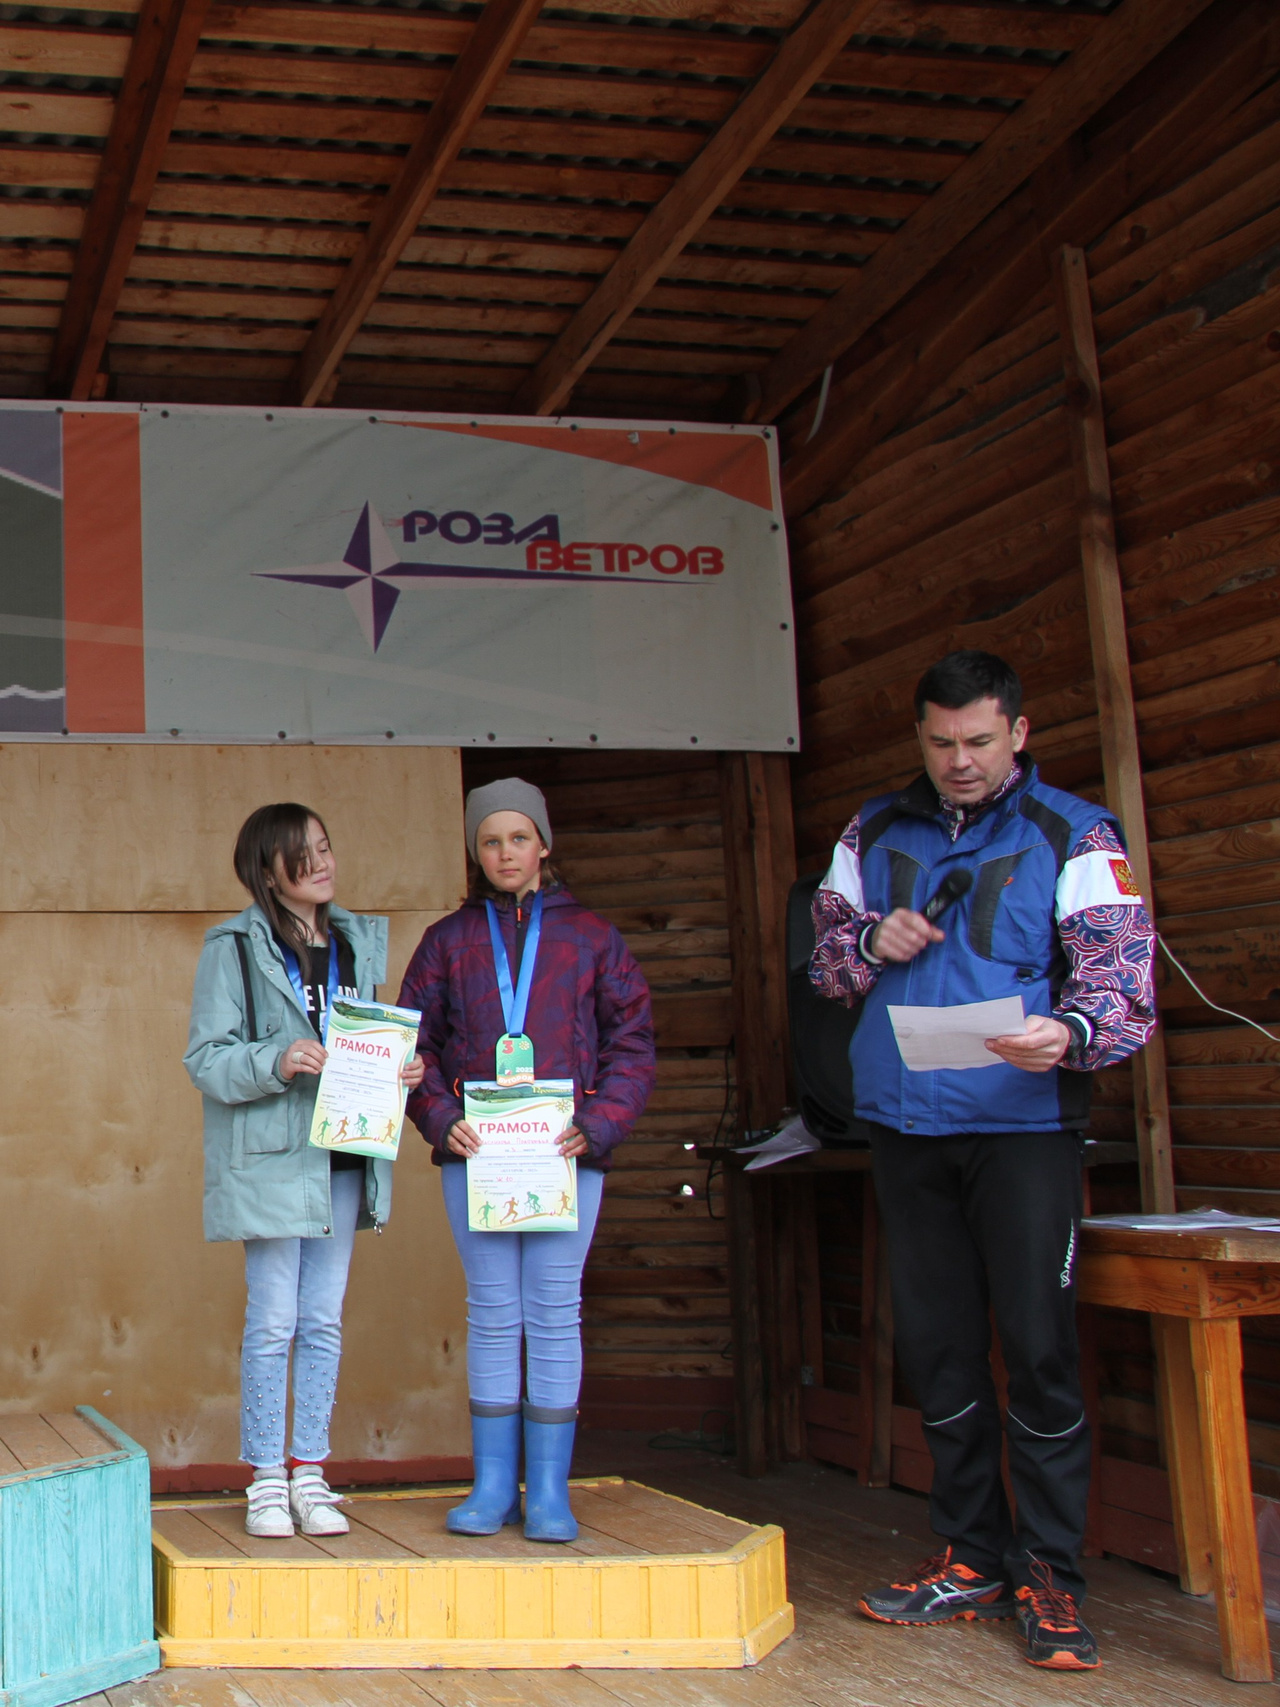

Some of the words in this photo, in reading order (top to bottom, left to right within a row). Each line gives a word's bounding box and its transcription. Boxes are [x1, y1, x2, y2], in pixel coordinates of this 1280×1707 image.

[402, 511, 560, 546] РОЗА
[525, 539, 724, 576] ВЕТРОВ
[334, 1037, 391, 1059] ГРАМОТА
[502, 1040, 514, 1054] 3
[478, 1121, 550, 1134] ГРАМОТА
